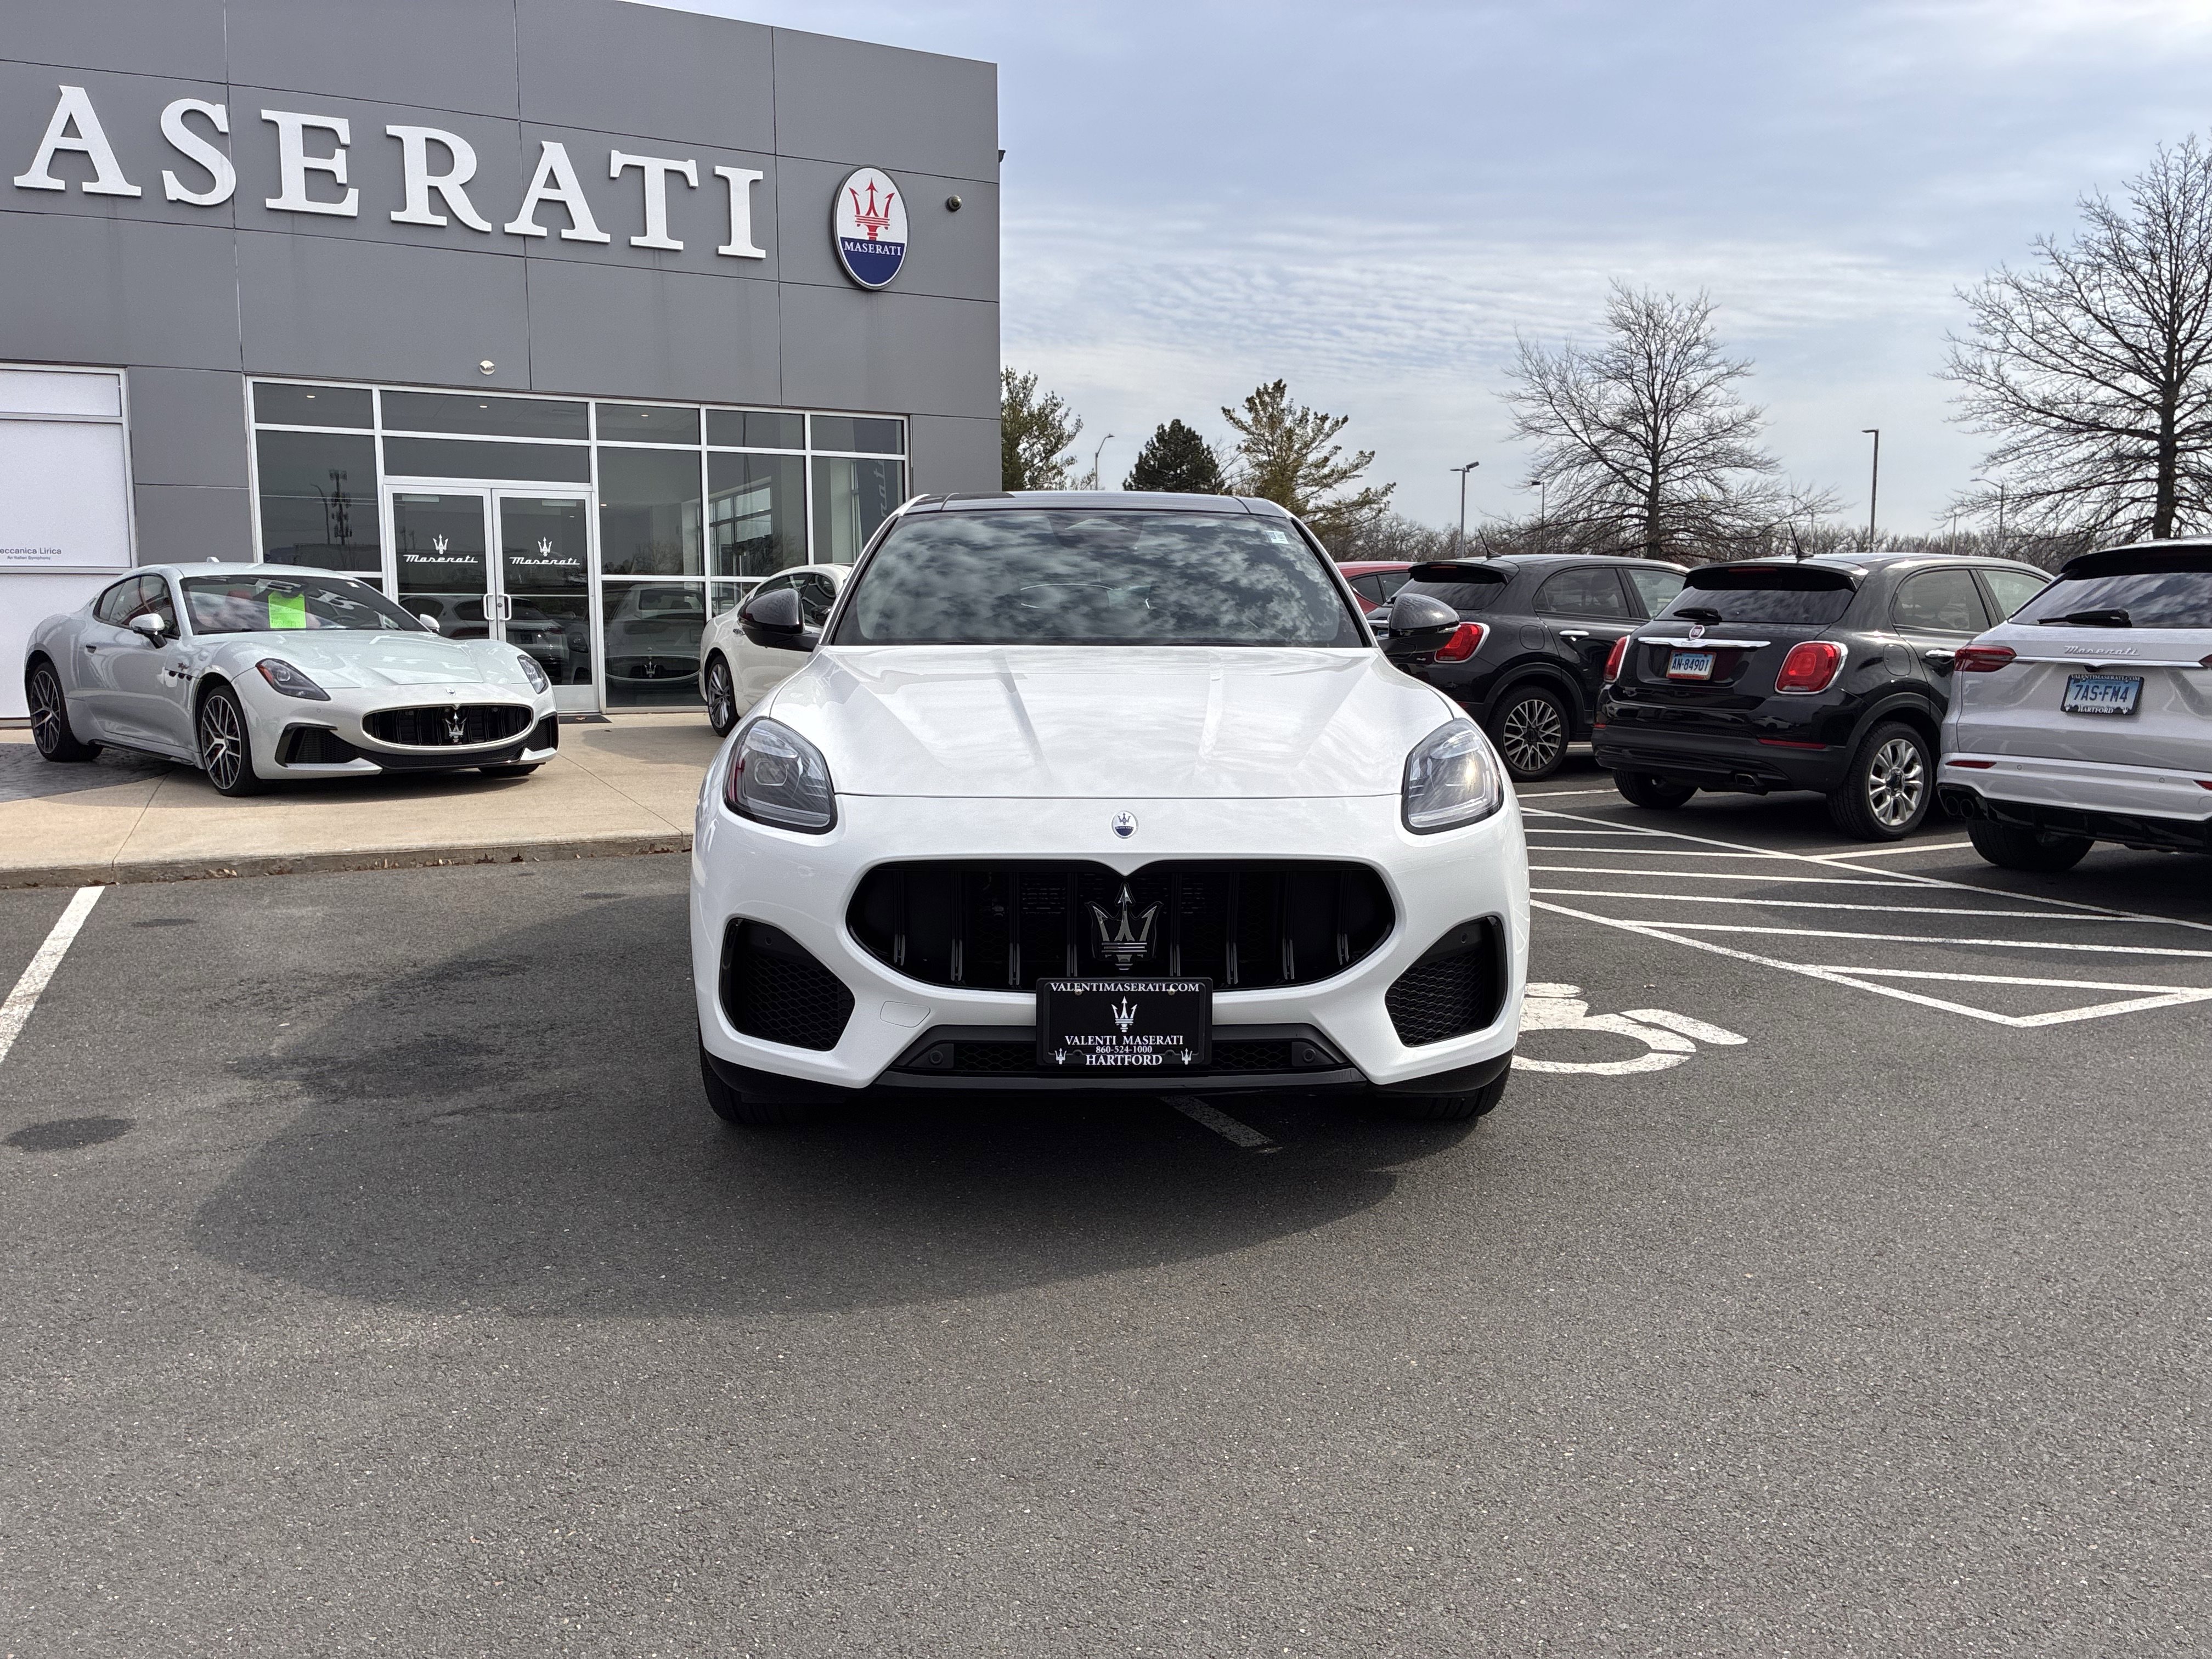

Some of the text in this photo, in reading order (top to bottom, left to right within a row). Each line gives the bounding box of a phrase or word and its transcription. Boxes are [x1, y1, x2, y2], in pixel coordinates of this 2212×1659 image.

[13, 84, 766, 259] ASERATI
[844, 241, 901, 256] MASERATI
[403, 555, 479, 563] Maserati
[509, 557, 580, 565] Maserati
[2064, 646, 2140, 656] Maserati
[1051, 983, 1200, 992] VALENTIMASERATI.COM
[1065, 1035, 1183, 1045] VALENTI MASERATI
[1086, 1055, 1163, 1065] HARTFORD
